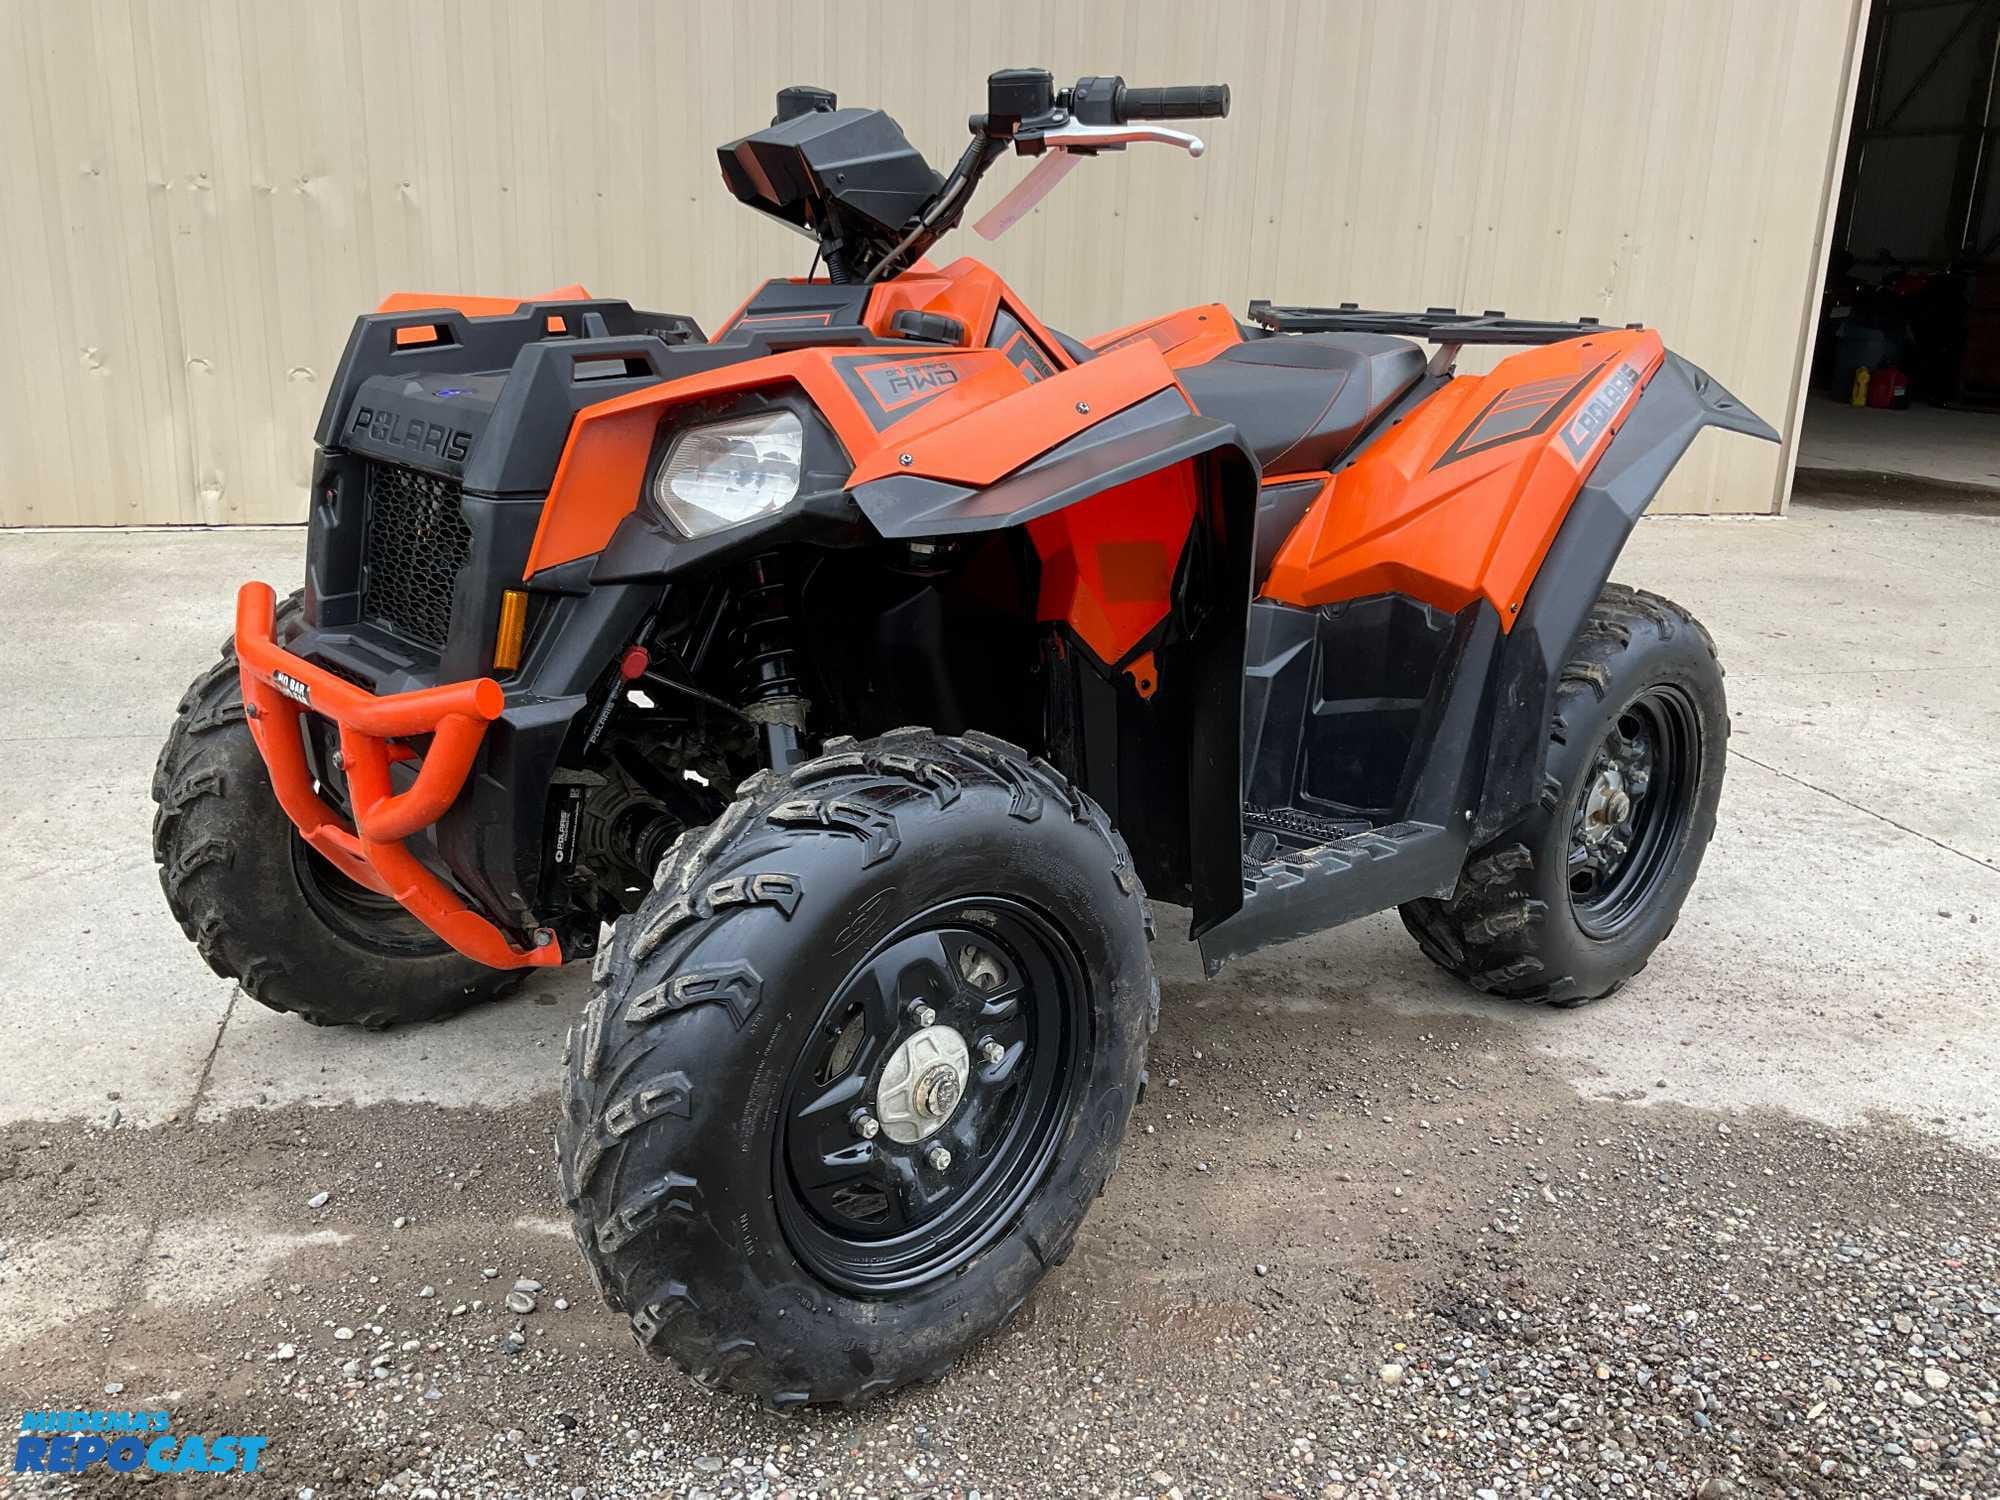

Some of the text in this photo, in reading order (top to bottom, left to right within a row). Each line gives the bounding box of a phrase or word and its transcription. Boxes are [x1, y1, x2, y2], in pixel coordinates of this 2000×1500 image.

[889, 370, 958, 394] AWD
[351, 406, 473, 462] POLARIS
[557, 809, 569, 850] POLARIS
